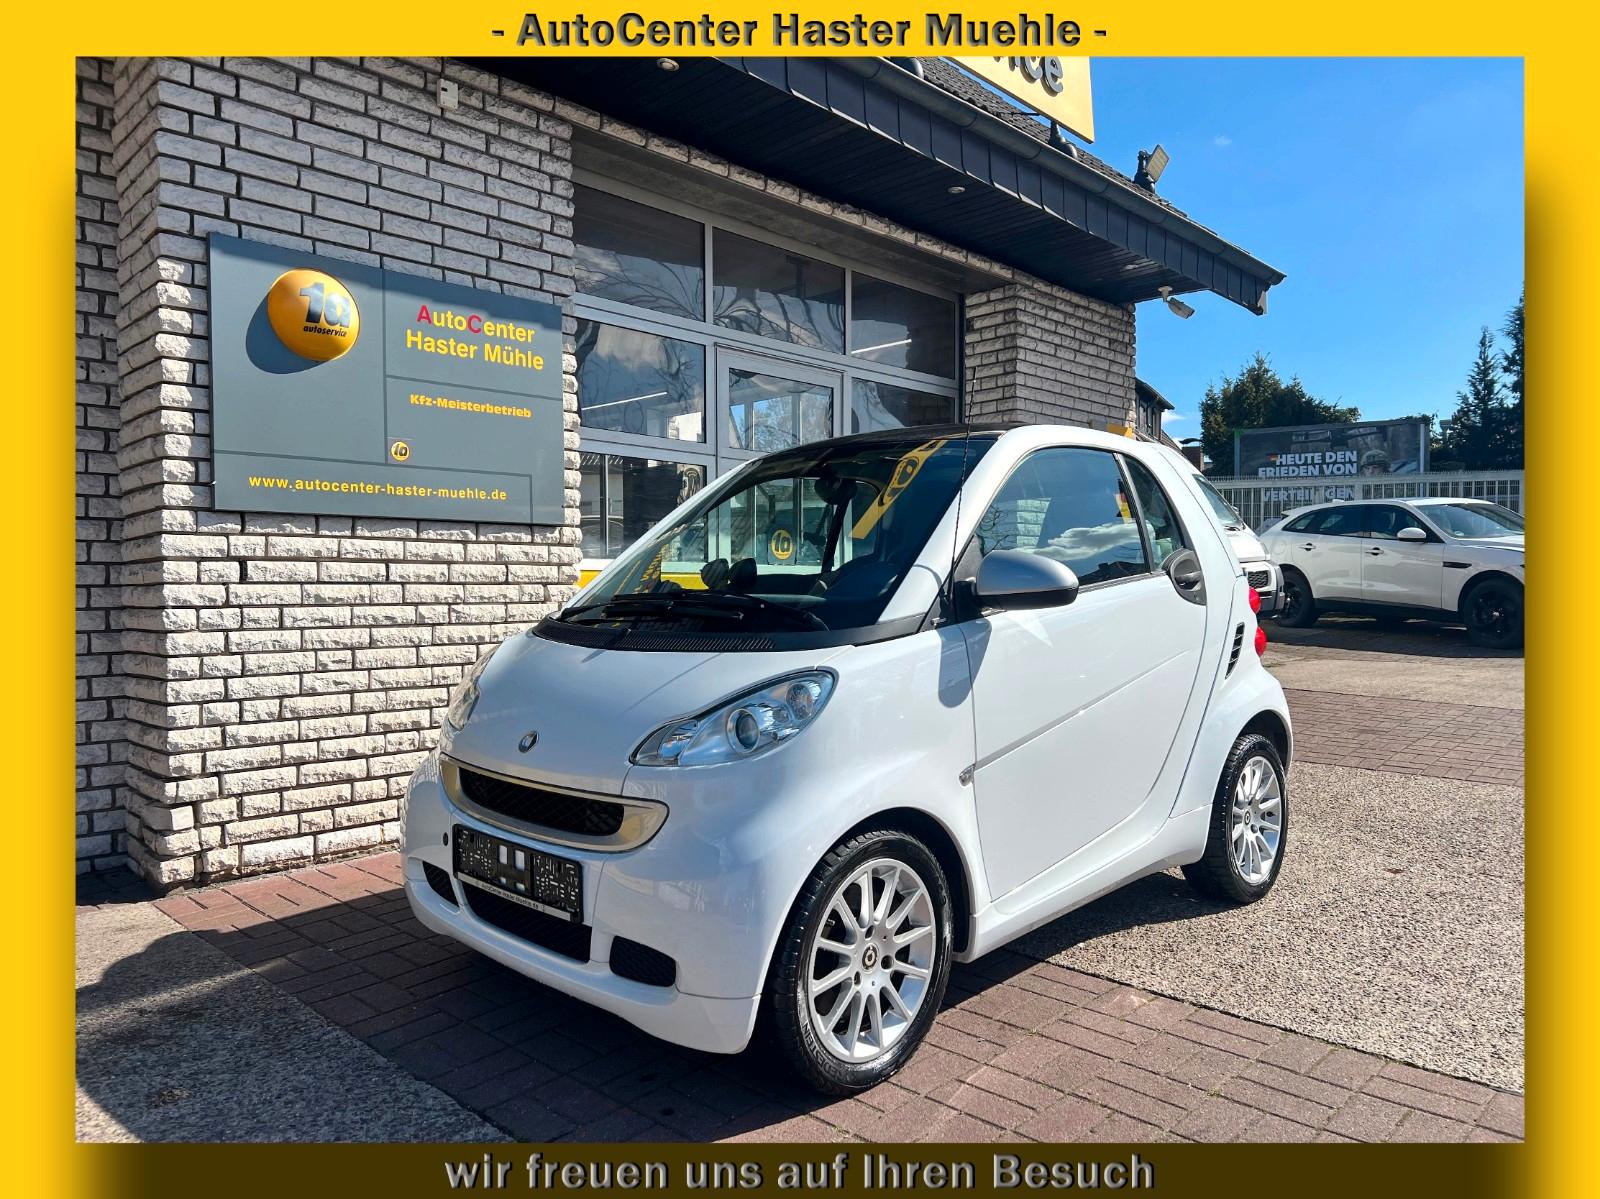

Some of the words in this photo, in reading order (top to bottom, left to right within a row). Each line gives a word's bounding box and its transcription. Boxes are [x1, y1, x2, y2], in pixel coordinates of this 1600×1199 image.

[299, 281, 351, 329] 1a
[303, 324, 348, 338] autoservice
[416, 304, 535, 343] AutoCenter
[406, 328, 478, 359] Haster
[484, 343, 544, 370] Mühle
[409, 393, 533, 418] Kfz-Meisterbetrieb
[1258, 463, 1320, 478] FRIEDEN
[1322, 462, 1358, 476] VON
[1276, 452, 1323, 466] HEUTE
[1325, 450, 1358, 463] DEN
[248, 475, 508, 501] www.autocenter-haster-muehle.de
